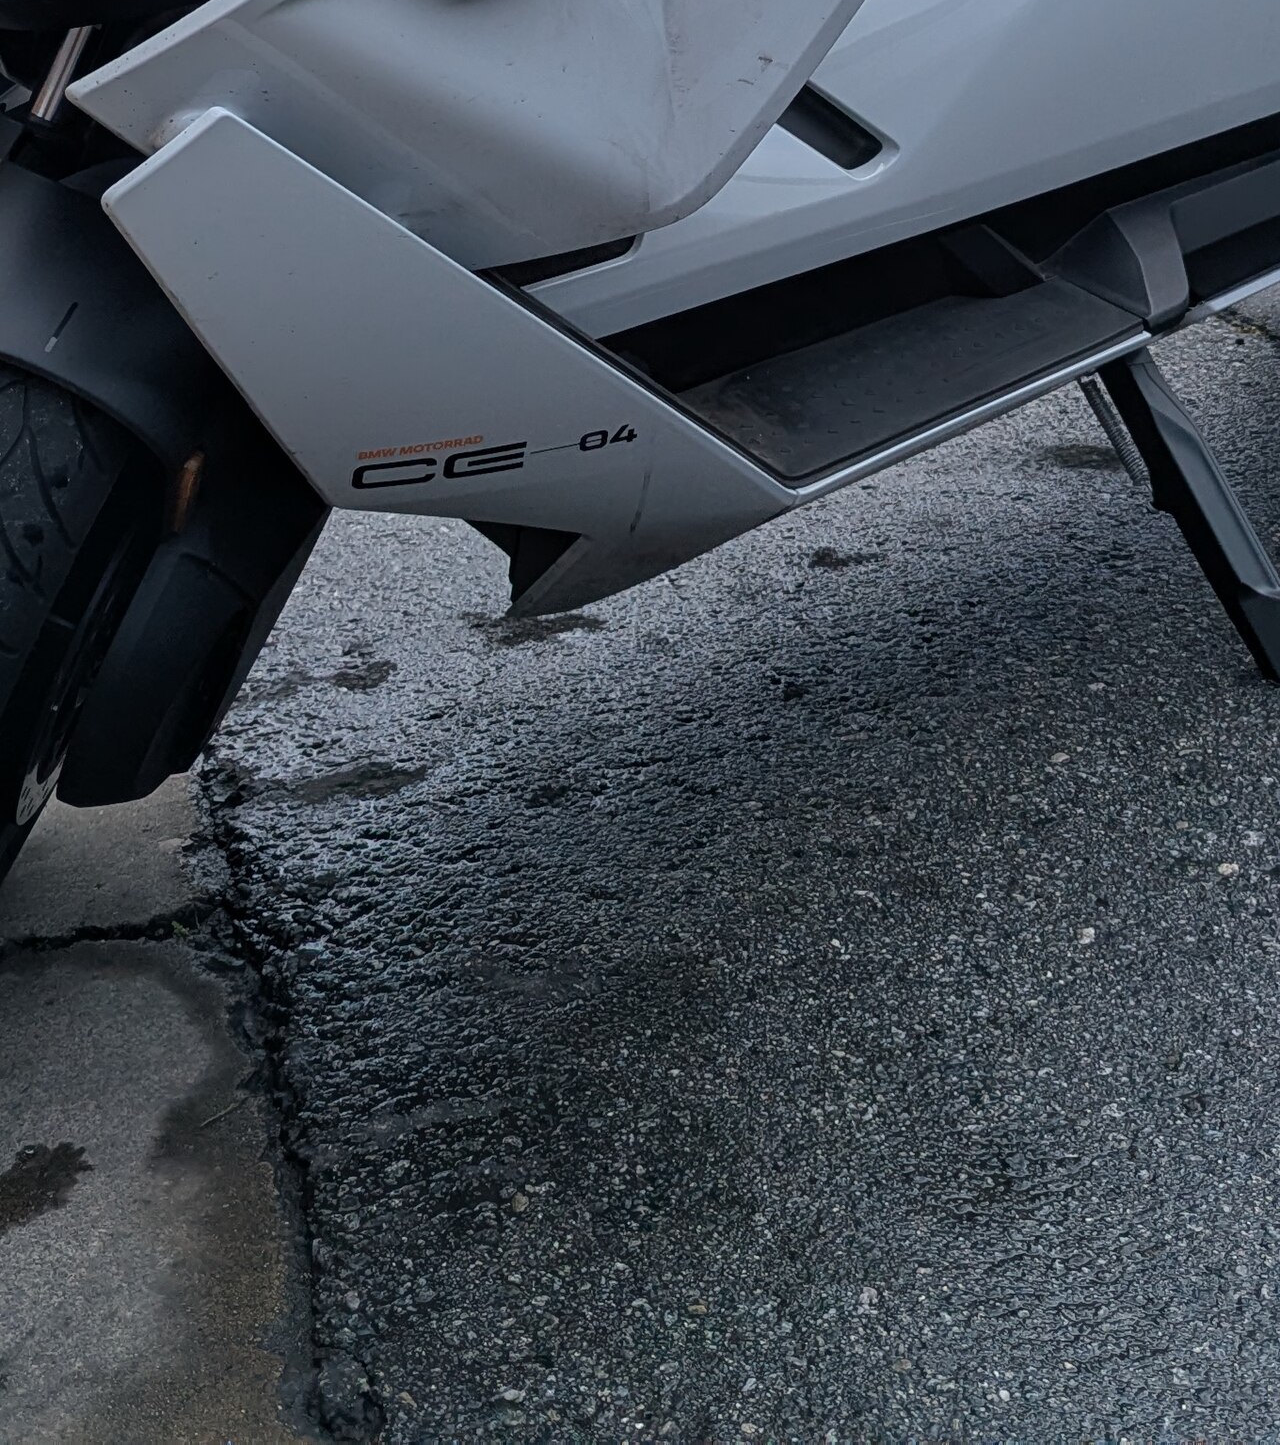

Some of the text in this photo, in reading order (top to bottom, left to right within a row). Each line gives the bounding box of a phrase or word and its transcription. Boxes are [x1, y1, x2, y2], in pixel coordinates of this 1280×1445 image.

[351, 423, 639, 490] CE 04
[357, 435, 485, 461] BMW MOTORRAD
